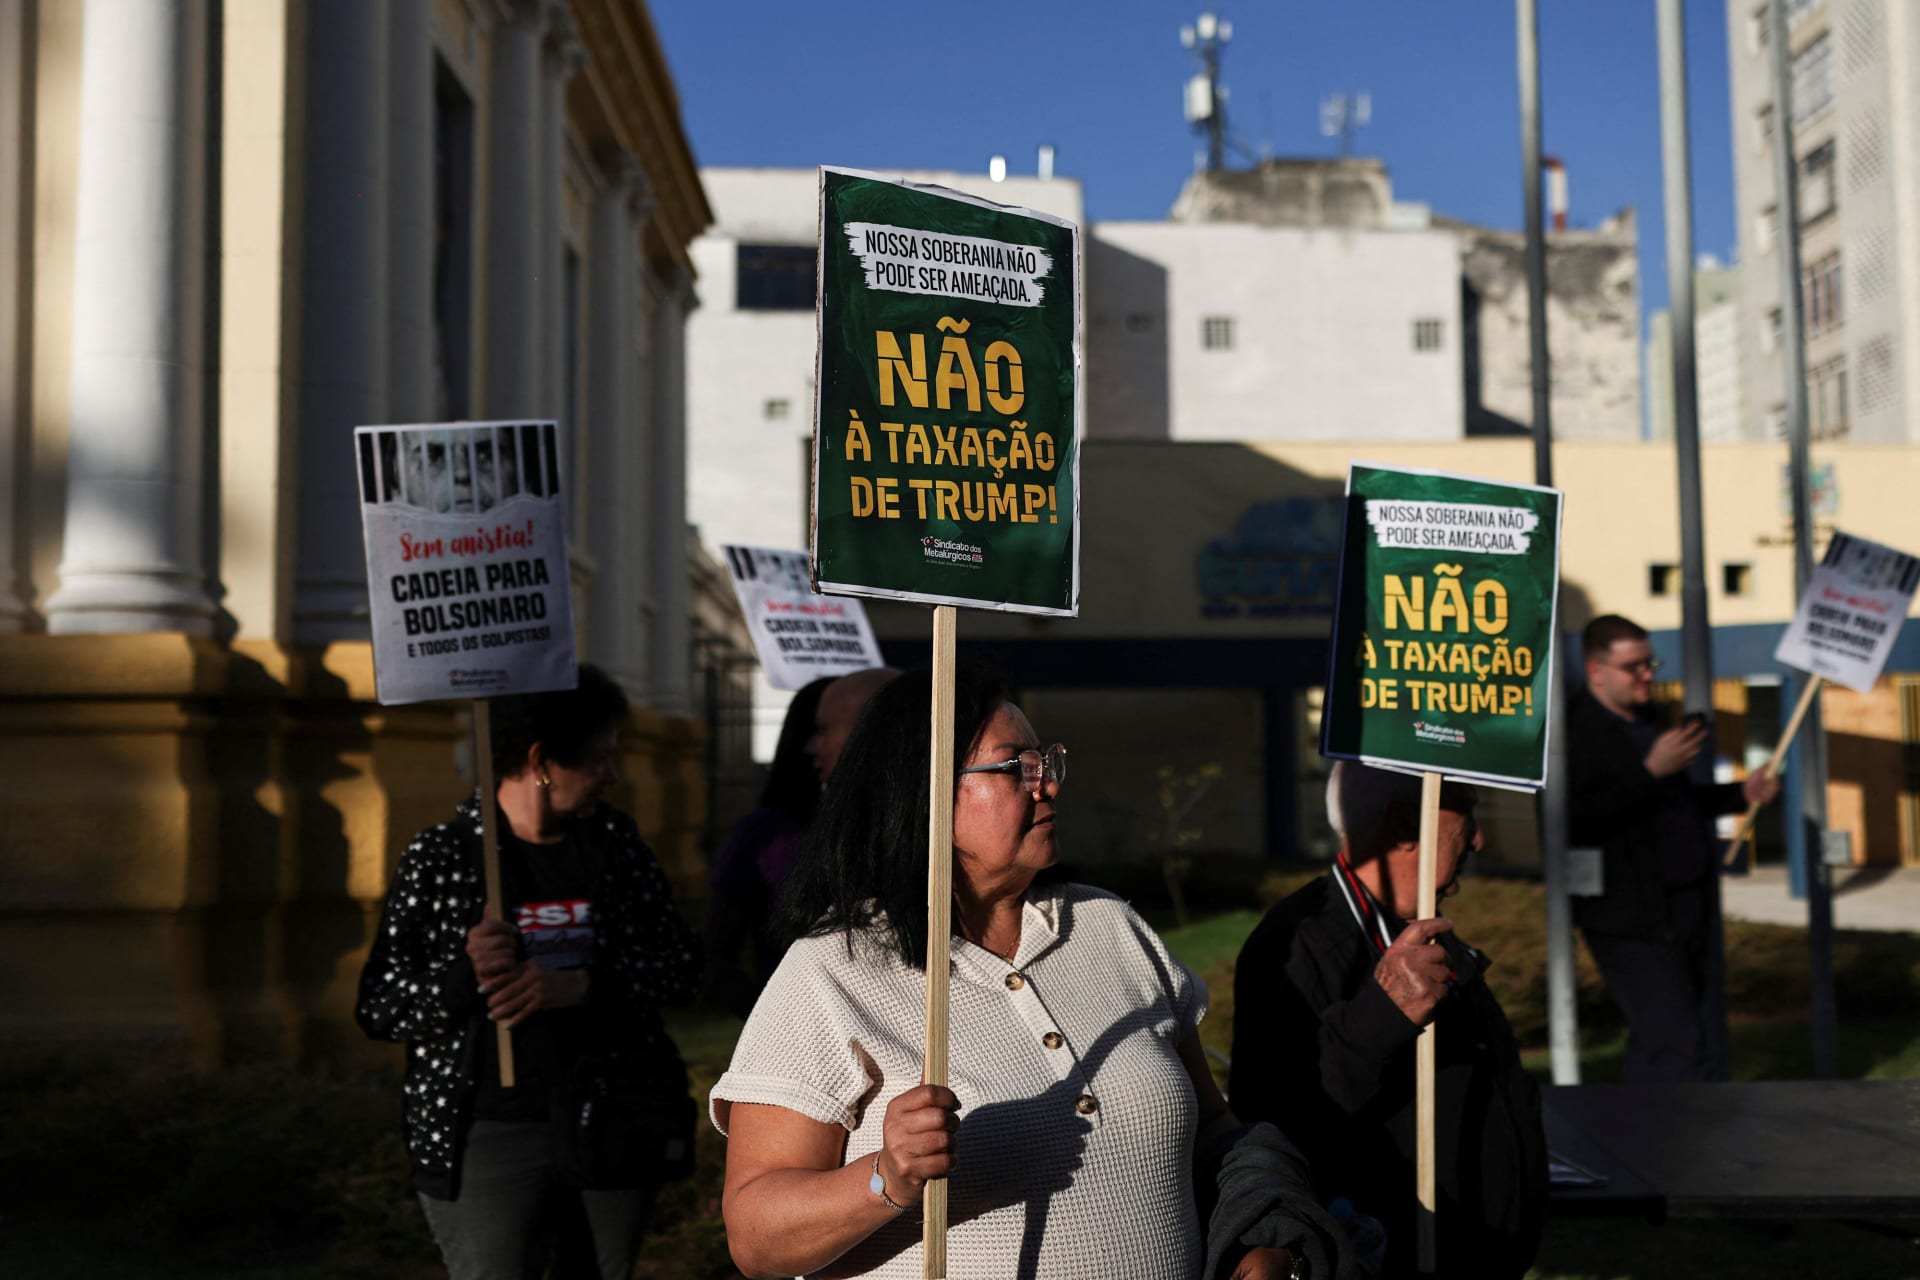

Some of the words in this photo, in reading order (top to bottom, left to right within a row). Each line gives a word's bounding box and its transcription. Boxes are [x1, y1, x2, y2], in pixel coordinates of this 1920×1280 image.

[865, 229, 919, 260] NOSSA
[921, 237, 1004, 272] SOBERANIA
[1006, 246, 1036, 274] NÃO
[875, 260, 917, 288] PODE
[919, 266, 950, 292] SER
[951, 271, 1031, 303] AMEAÇADA.
[875, 316, 1025, 415] NÃO
[845, 409, 871, 462] À
[879, 421, 1055, 478] TAXAÇÃO
[850, 476, 900, 519] DE
[909, 478, 1058, 524] TRUMP!
[1379, 505, 1423, 523] NOSSA
[1426, 507, 1496, 527] SOBERANIA
[1498, 508, 1524, 530] NÃO
[400, 532, 443, 562] Sem
[450, 519, 534, 558] anistia!
[924, 547, 971, 562] Metalúrgicos
[934, 538, 969, 552] Sindicato
[1386, 527, 1420, 545] PODE
[1422, 528, 1445, 546] SER
[1448, 530, 1518, 553] AMEAÇADA.
[391, 566, 480, 603] CADEIA
[485, 558, 549, 592] PARA
[1384, 563, 1508, 635] NÃO
[403, 592, 547, 636] BOLSONARO
[408, 643, 417, 658] E
[418, 639, 460, 657] TODOS
[462, 635, 479, 652] OS
[1384, 637, 1532, 681] TAXAÇÃO
[1361, 678, 1398, 710] DE
[1405, 680, 1533, 716] TRUMP!
